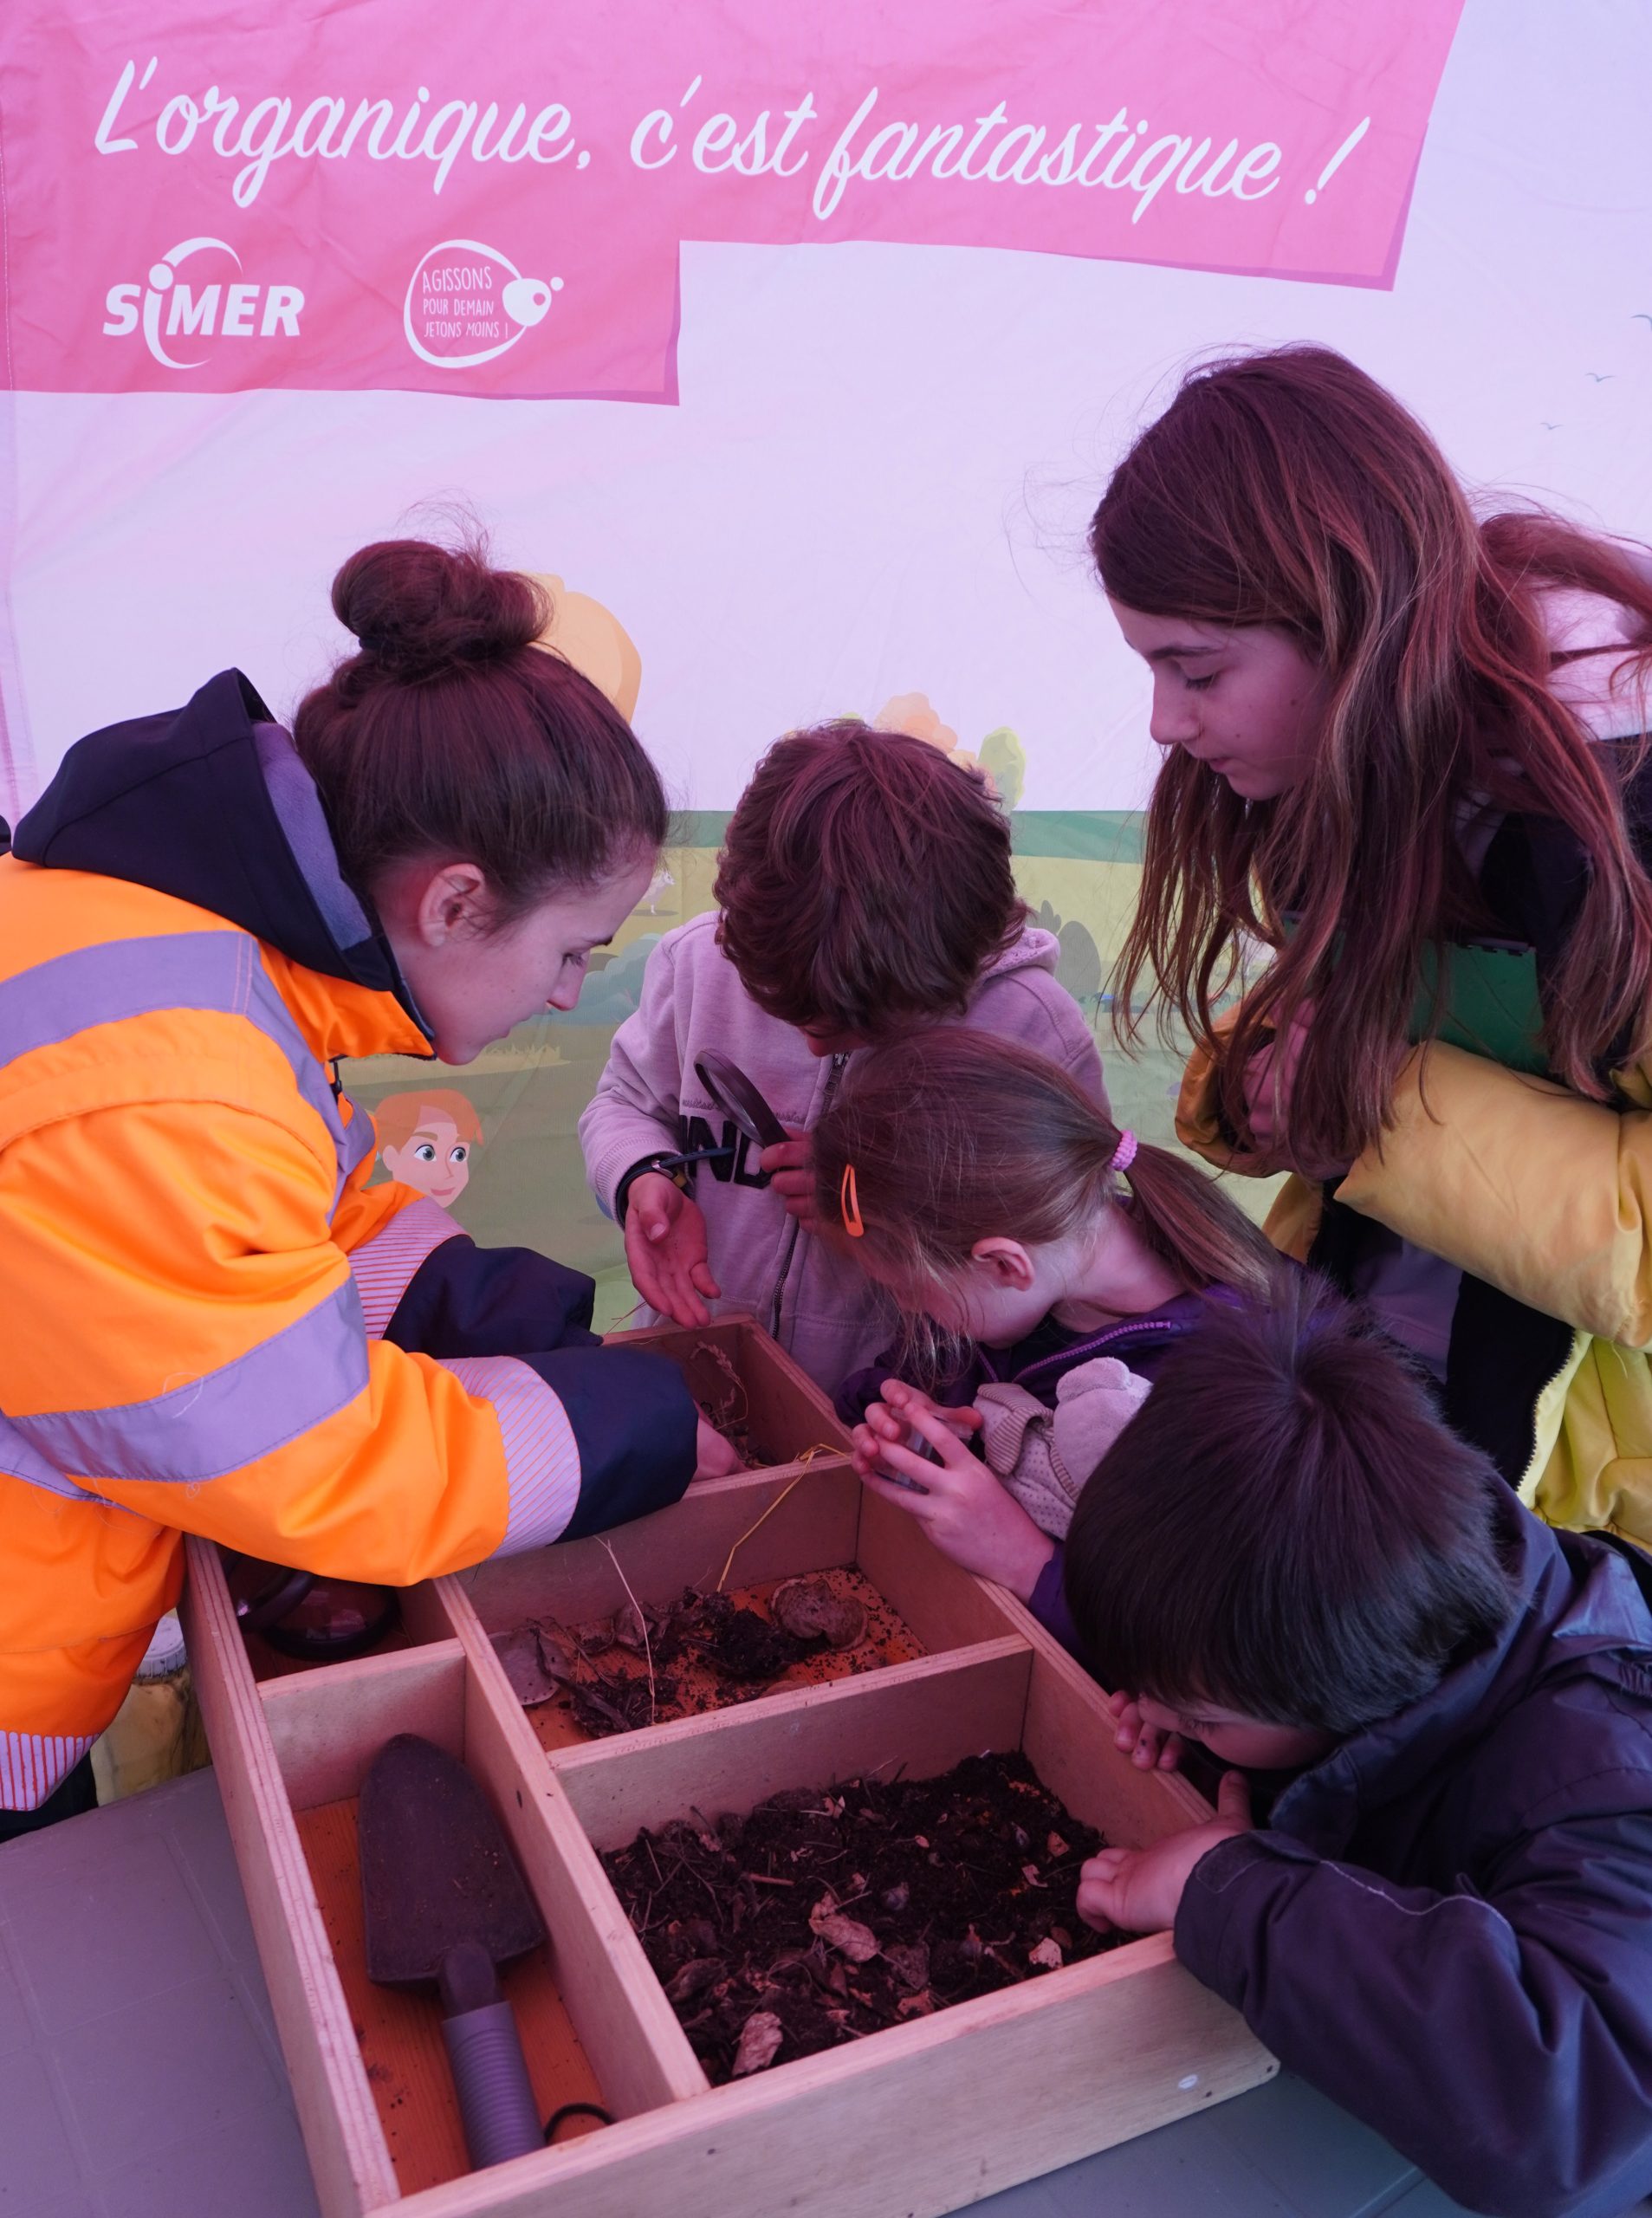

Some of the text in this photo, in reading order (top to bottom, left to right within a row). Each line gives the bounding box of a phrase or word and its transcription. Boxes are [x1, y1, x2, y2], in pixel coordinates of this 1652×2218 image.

[94, 56, 1370, 224] L'organique, c'est fantastique !
[422, 266, 493, 294] AGISSONS
[423, 298, 495, 317] POUR DEMAIN
[423, 321, 509, 340] JETONS MOINS !
